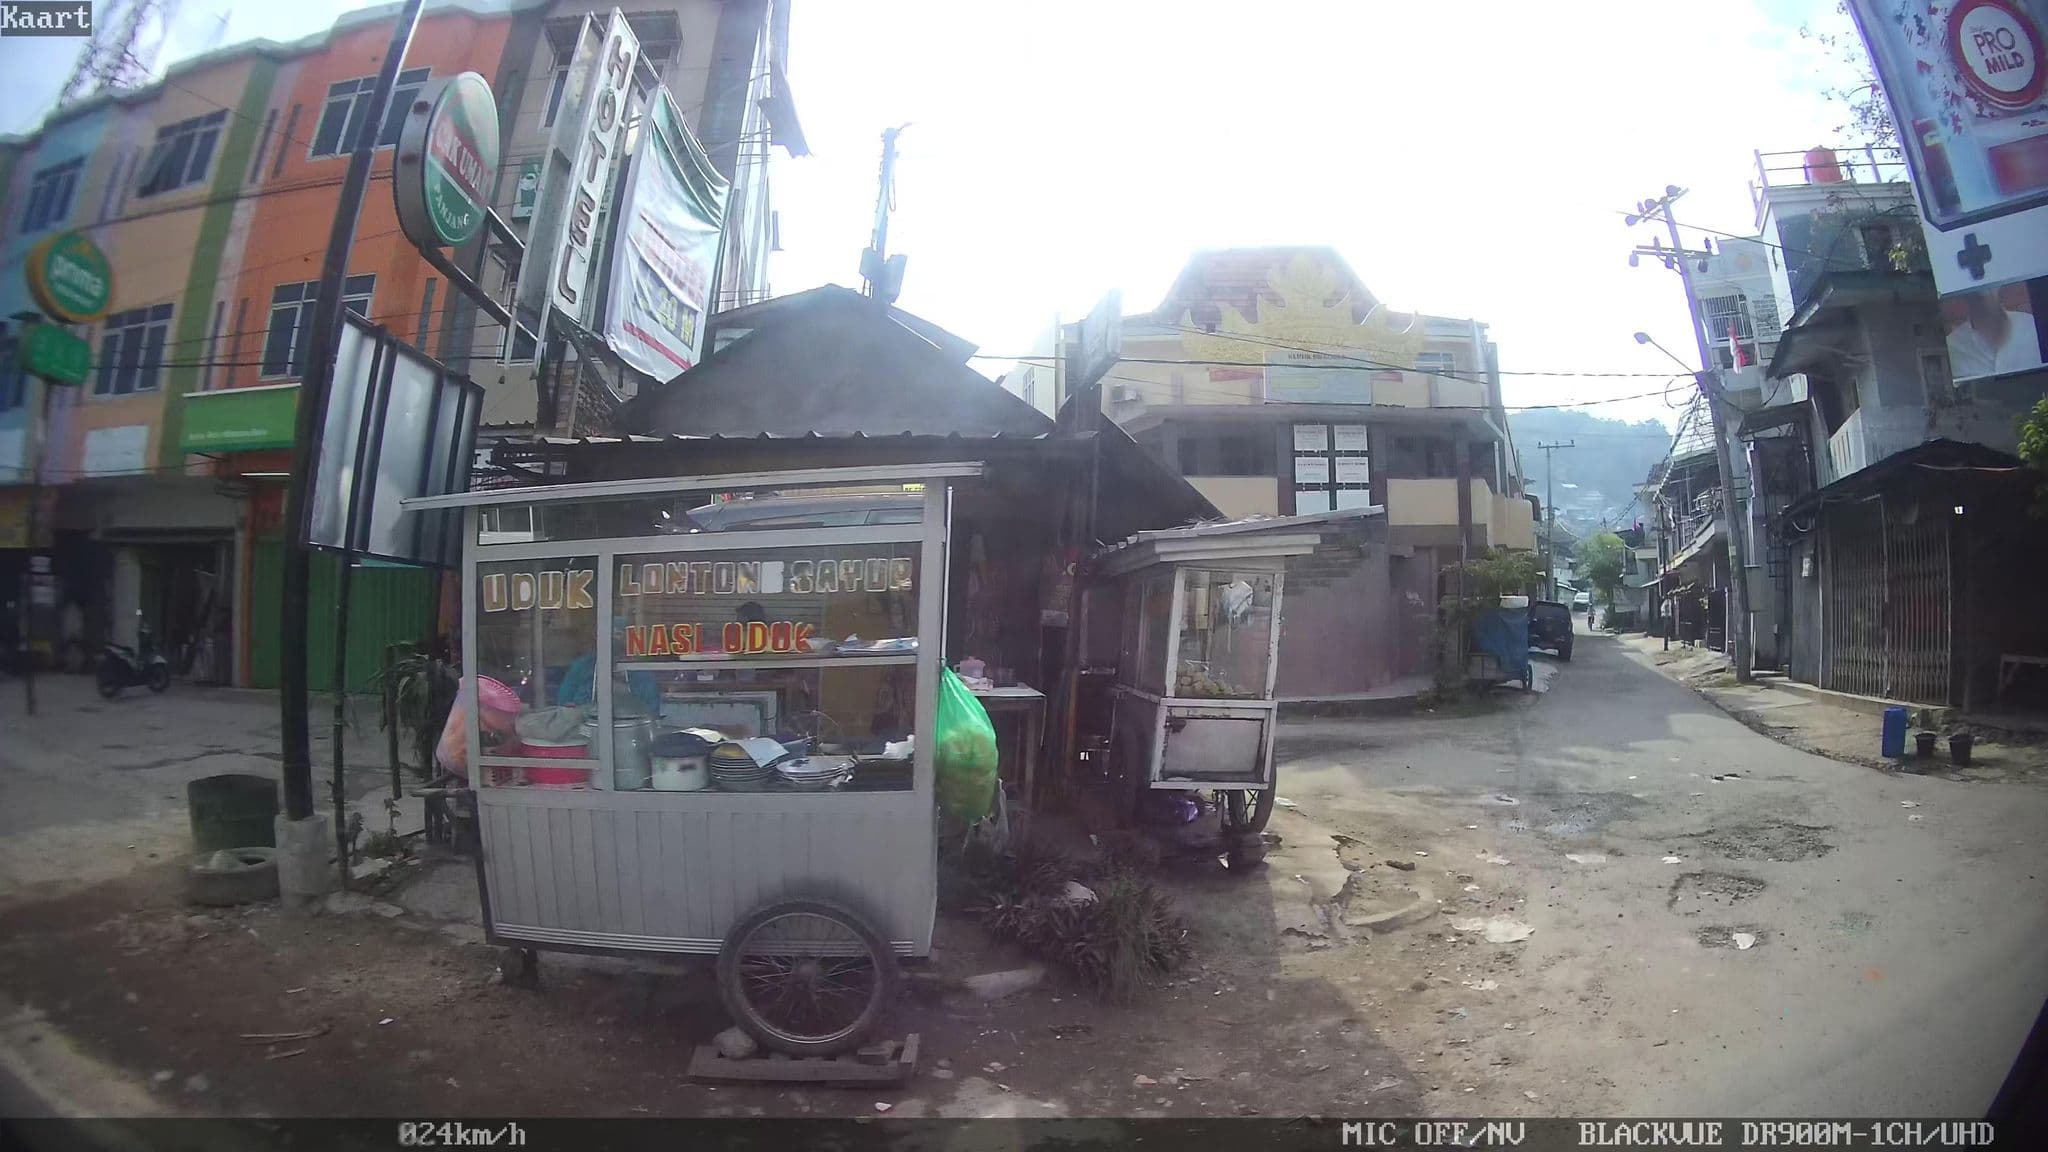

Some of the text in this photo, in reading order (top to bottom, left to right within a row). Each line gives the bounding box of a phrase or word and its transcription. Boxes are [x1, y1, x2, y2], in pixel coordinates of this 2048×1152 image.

[1973, 27, 2016, 56] PRO
[1985, 50, 2025, 75] MILD
[556, 33, 633, 306] HOTEL
[483, 570, 594, 612] UDUK
[790, 558, 913, 594] SAYUR
[625, 623, 703, 657] NASI
